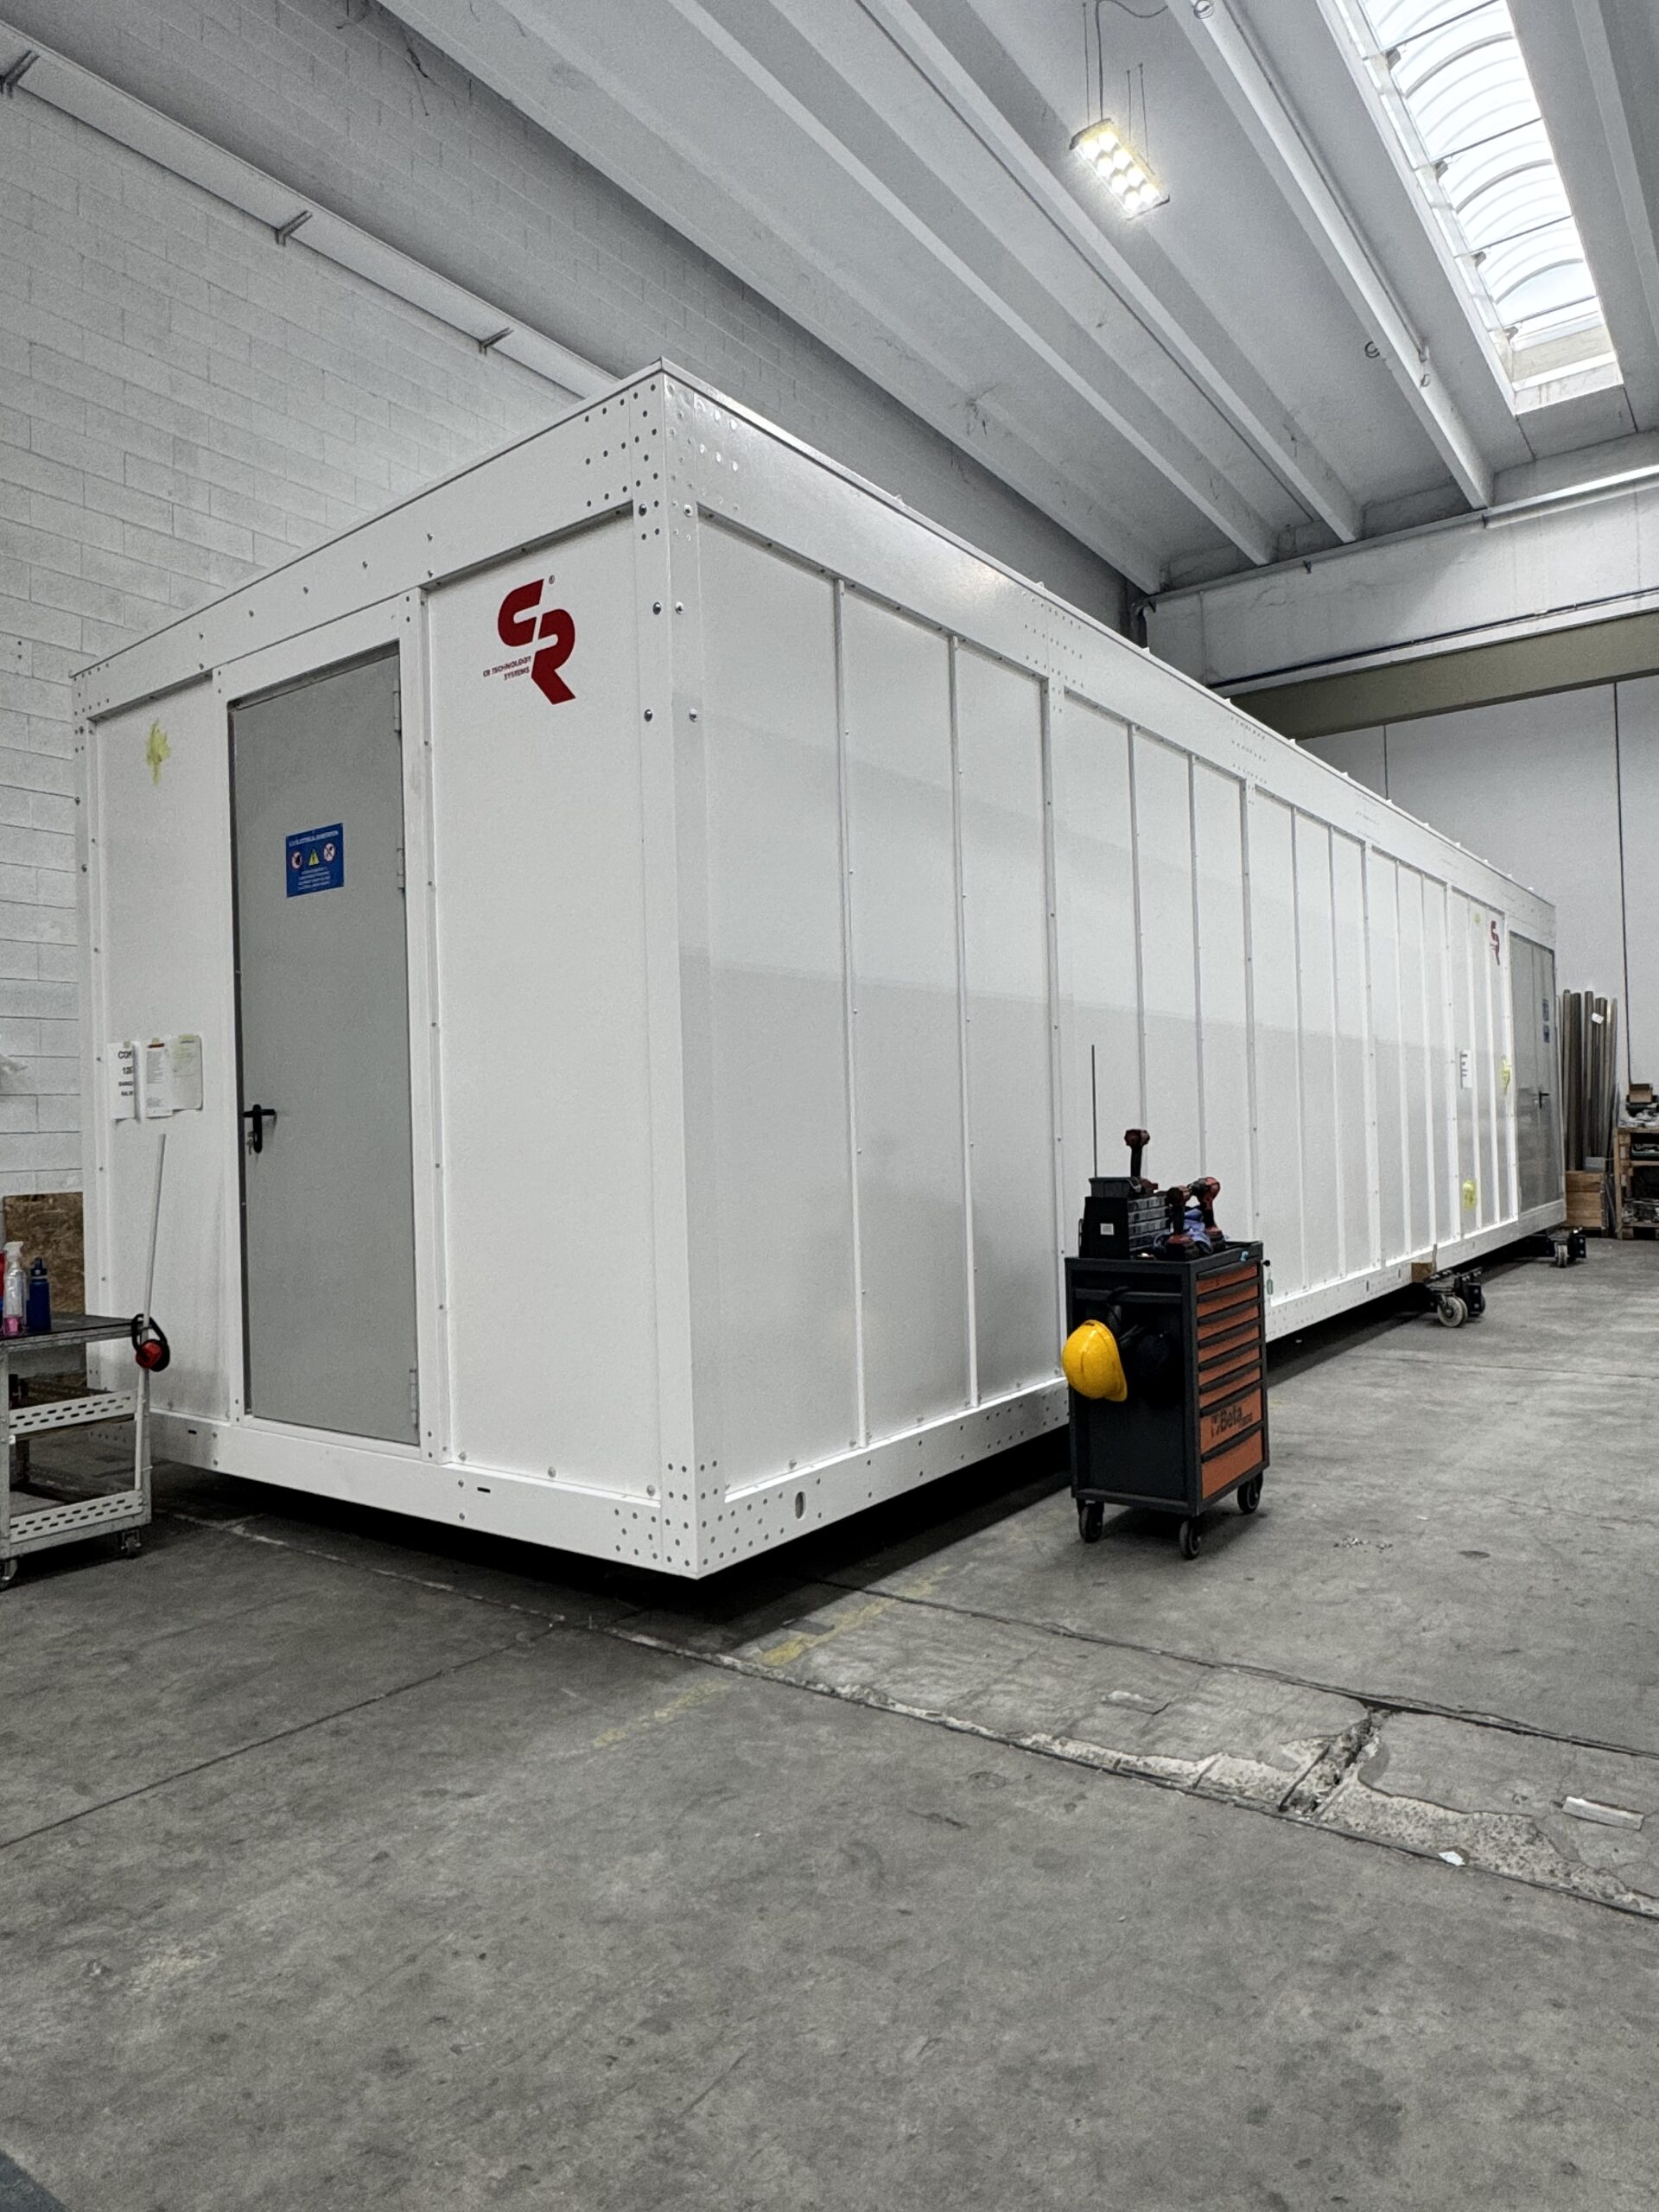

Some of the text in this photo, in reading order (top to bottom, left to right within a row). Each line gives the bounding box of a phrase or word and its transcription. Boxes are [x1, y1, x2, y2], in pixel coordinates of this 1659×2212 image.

[492, 655, 531, 675] TECHNOLOGY
[504, 666, 530, 681] SYSTEMS
[1220, 1405, 1243, 1433] Beta
